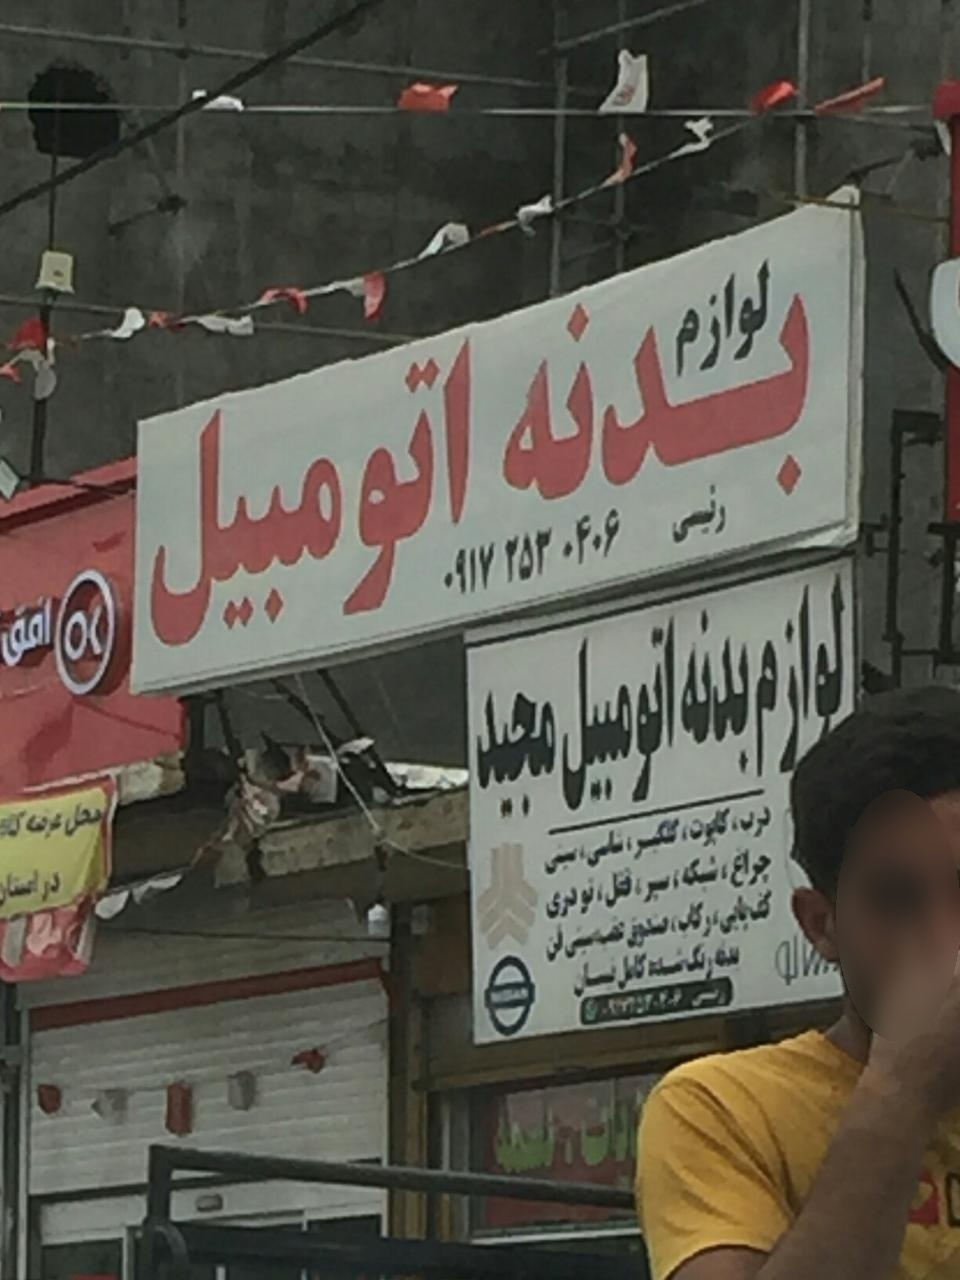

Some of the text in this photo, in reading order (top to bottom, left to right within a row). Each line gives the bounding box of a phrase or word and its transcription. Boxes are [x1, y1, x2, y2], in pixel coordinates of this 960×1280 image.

[675, 260, 770, 376] لوازم
[150, 292, 809, 646] بدنه اتومبیل
[2, 597, 52, 667] افق
[477, 574, 845, 817] لوازم بدنه اتومبیل مجید
